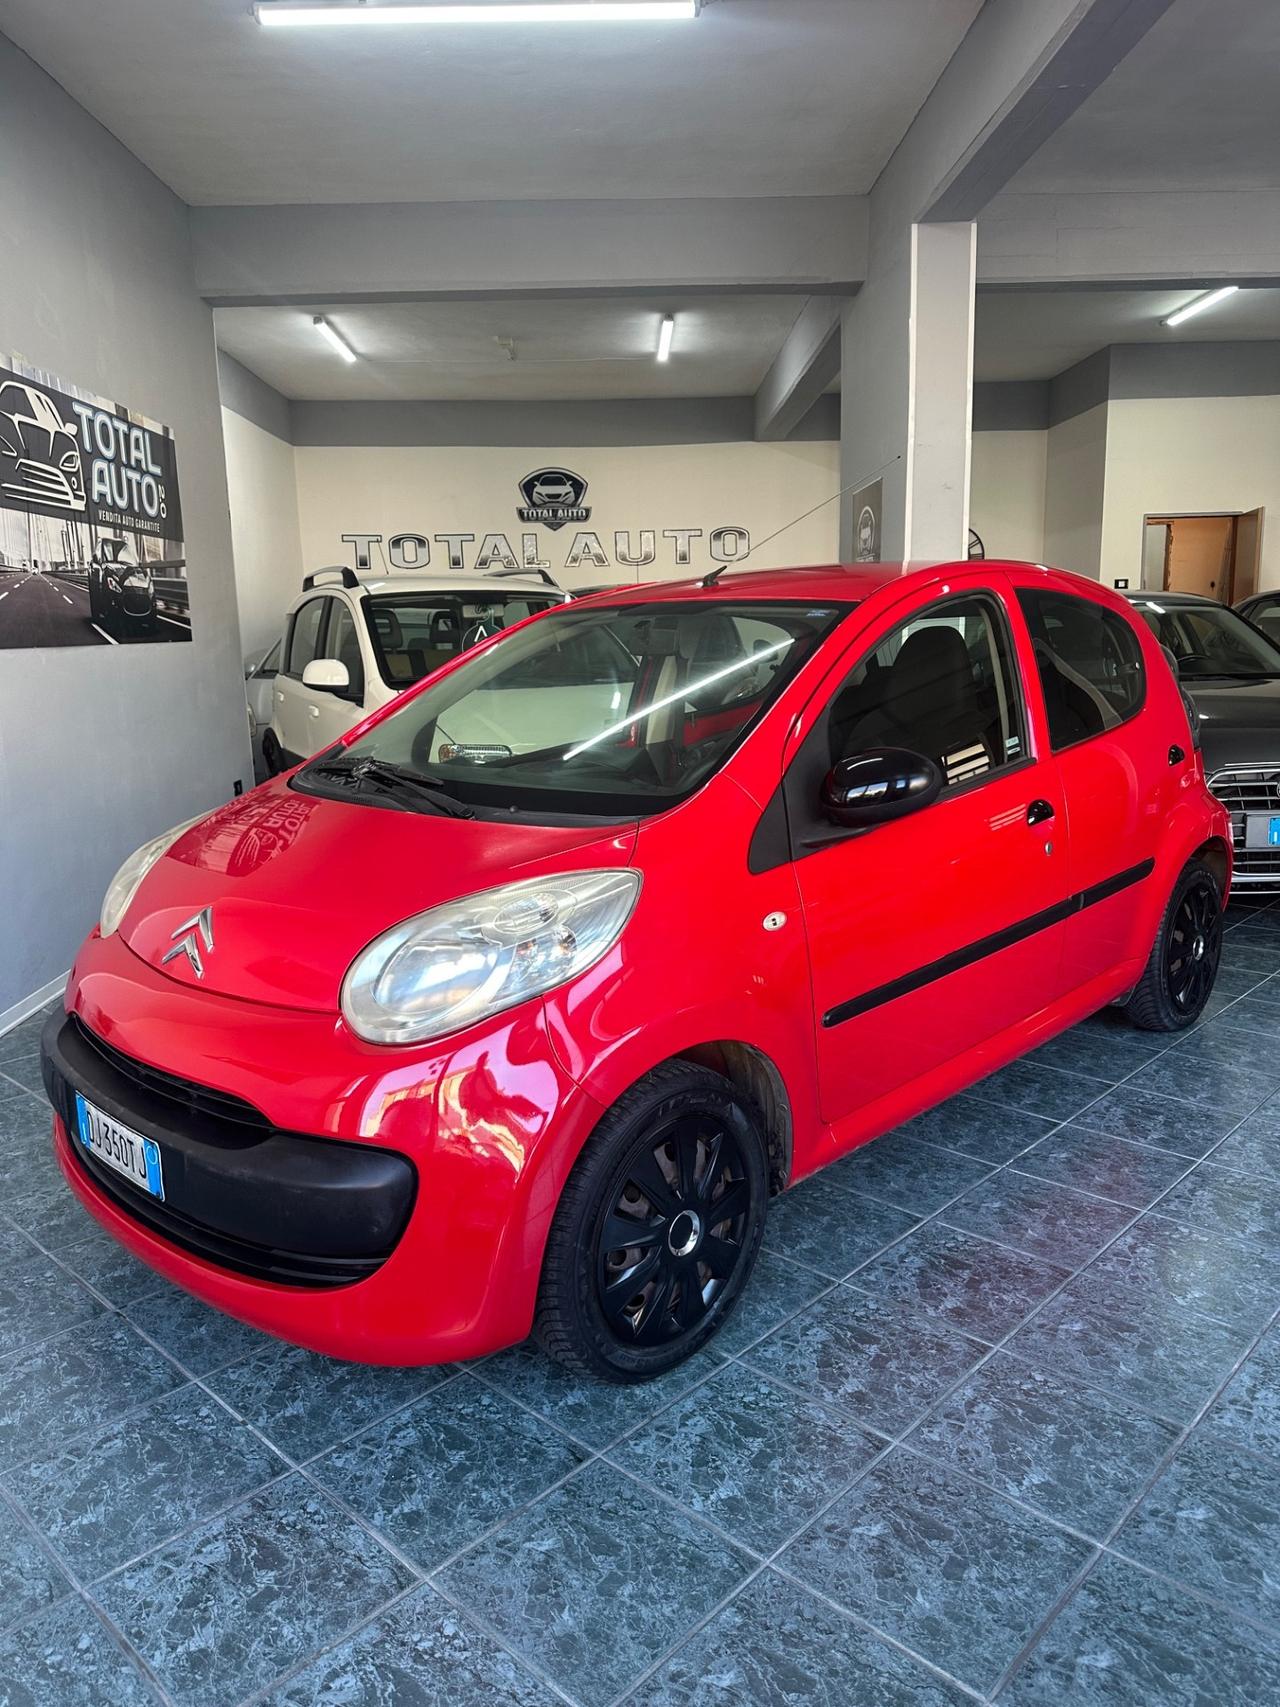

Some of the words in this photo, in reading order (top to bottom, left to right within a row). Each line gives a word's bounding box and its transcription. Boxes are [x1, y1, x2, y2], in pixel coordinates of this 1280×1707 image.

[72, 401, 162, 476] TOTAL
[91, 458, 159, 518] AUTO
[521, 508, 553, 518] TOTAL
[557, 508, 586, 518] AUTO
[98, 509, 121, 524] VENDITA
[122, 514, 135, 527] AUTO
[341, 533, 550, 569] TOTAL
[564, 526, 750, 568] AUTO
[87, 1111, 147, 1179] DJ350TJ
